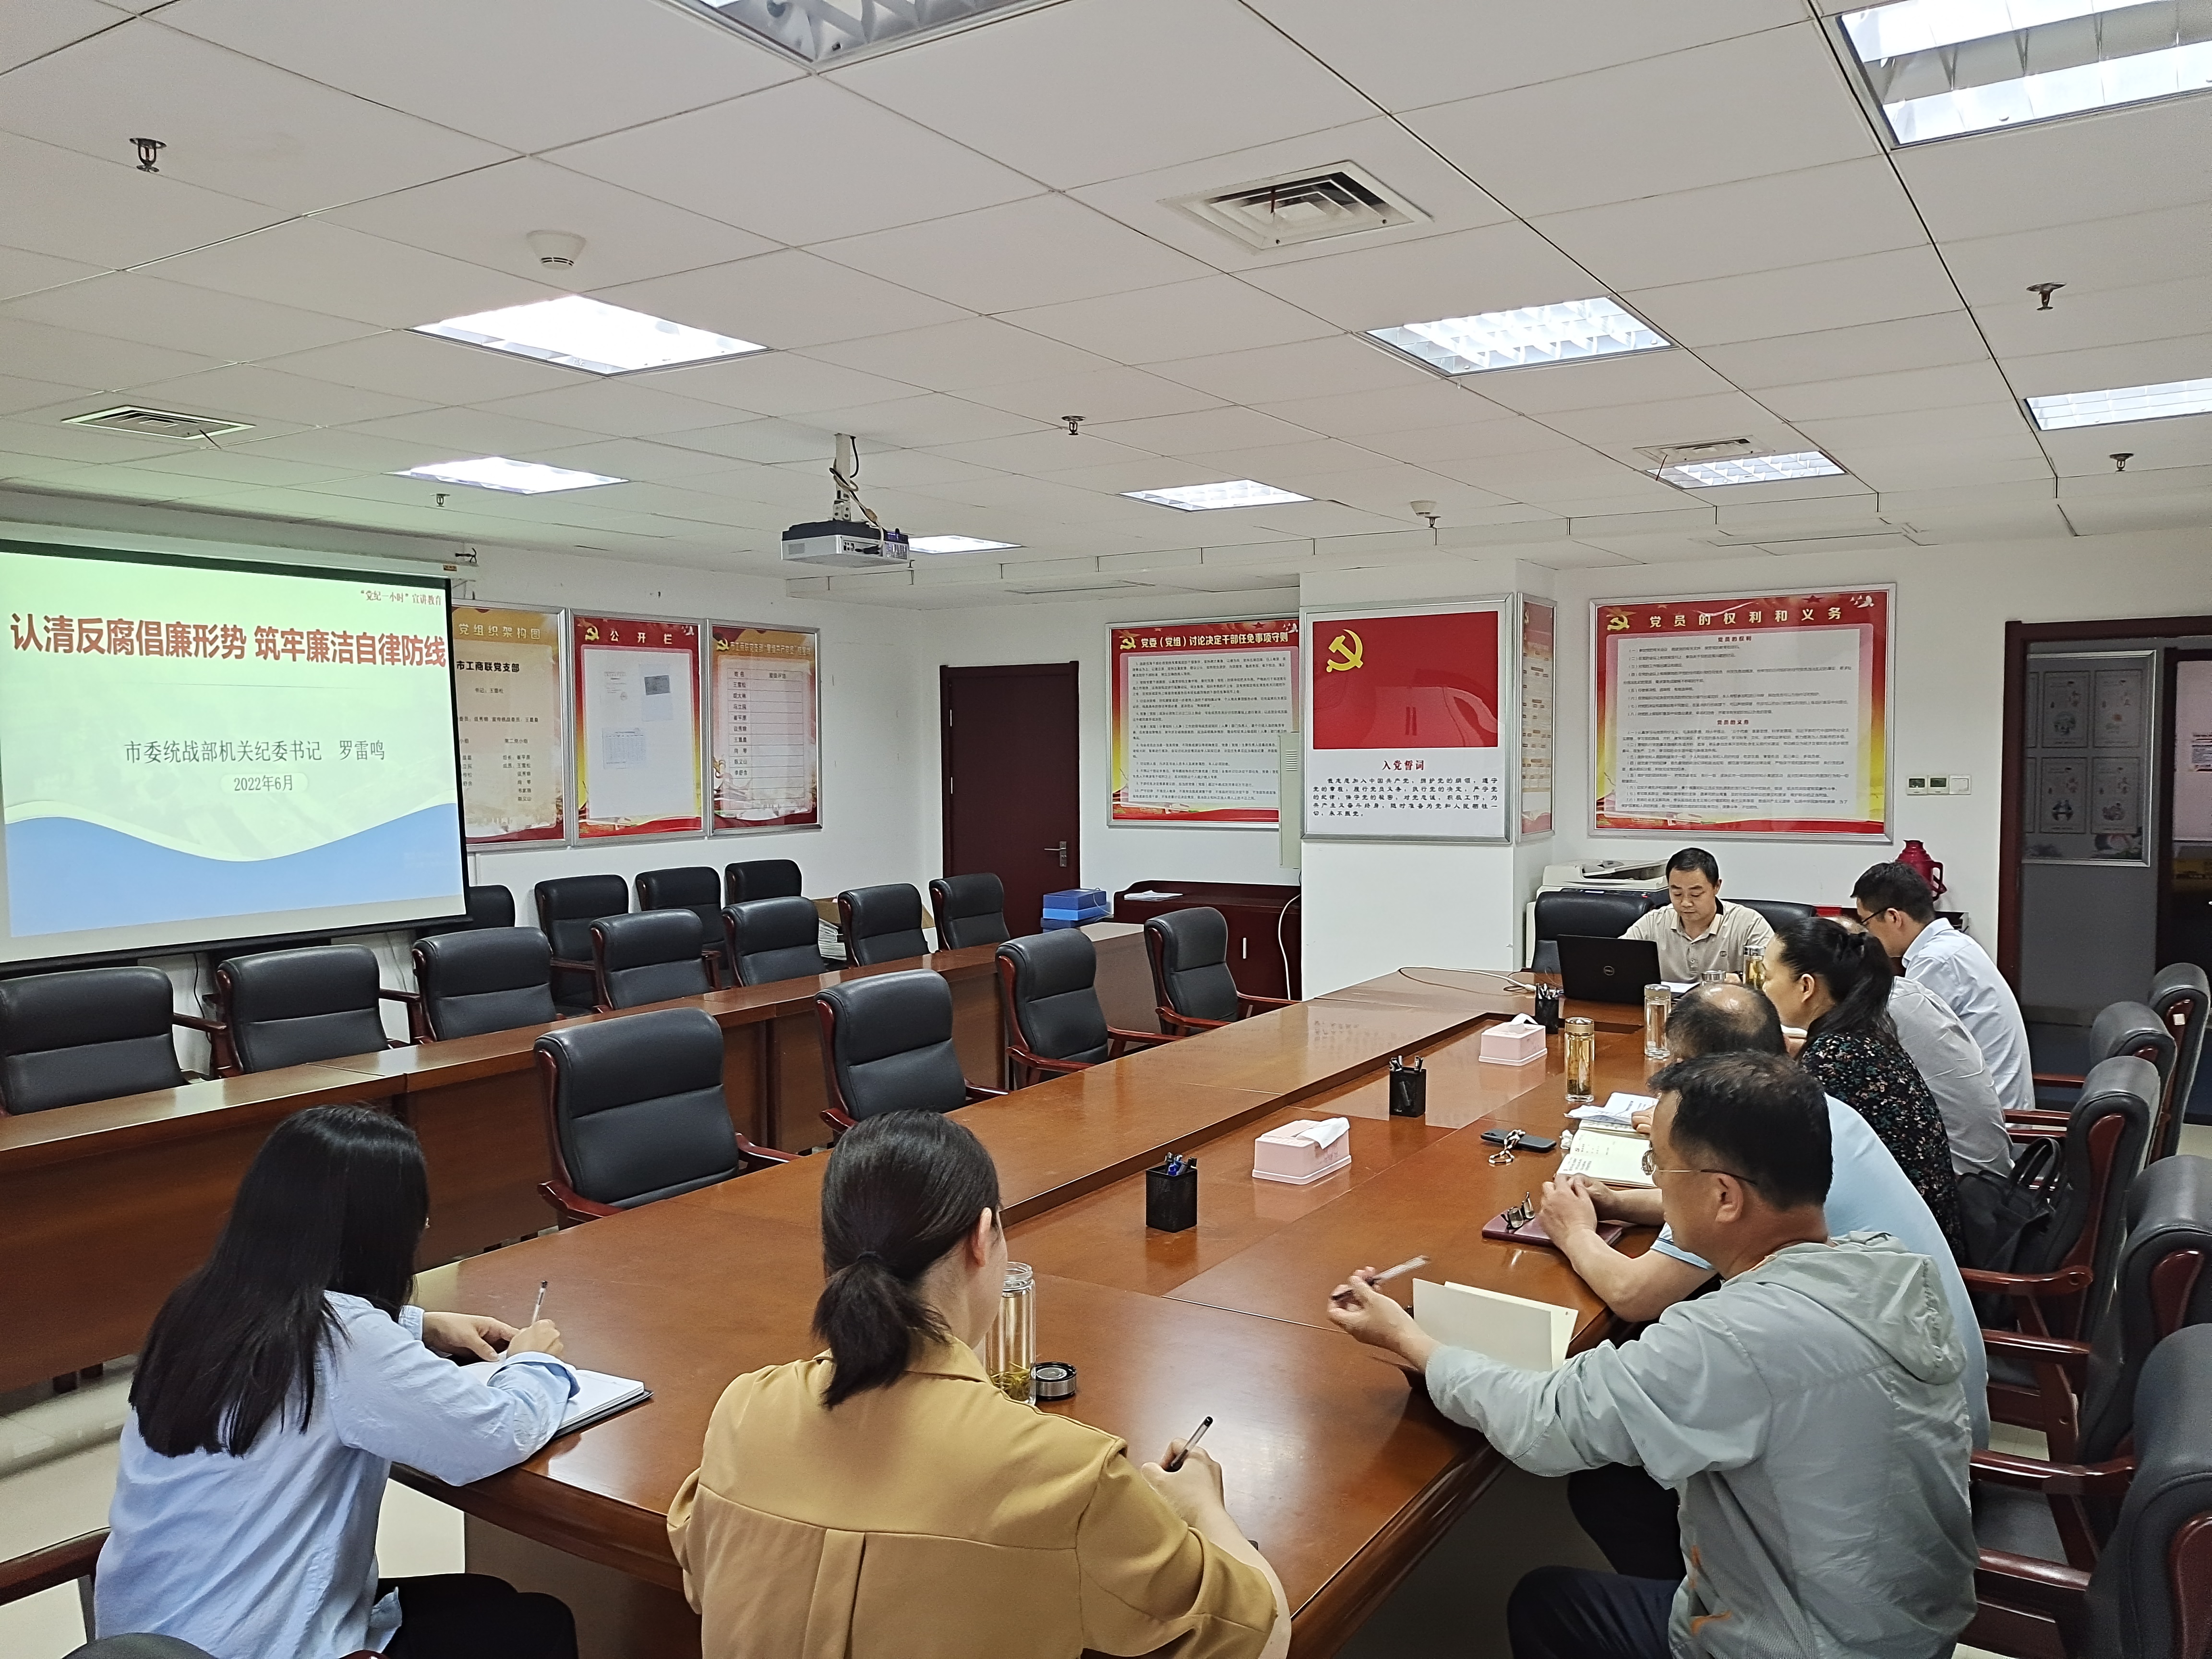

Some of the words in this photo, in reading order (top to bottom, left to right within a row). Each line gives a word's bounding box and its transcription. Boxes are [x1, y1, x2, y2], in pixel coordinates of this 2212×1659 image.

[1649, 607, 1841, 628] 党员的权利和义务
[458, 624, 541, 640] 党组织架构图
[610, 630, 673, 644] 公开栏
[1141, 632, 1288, 648] 党委（党组）讨论决定干部任免事项守则
[10, 613, 247, 660] 认清反腐倡廉形势
[254, 625, 447, 668] 筑牢廉洁自律防线
[457, 661, 520, 673] 市工商联党支部
[124, 739, 323, 765] 市委统战部机关纪委书记
[338, 740, 385, 761] 罗雷鸣
[1382, 760, 1425, 771] 入党誓词
[234, 774, 293, 792] 2022年6月
